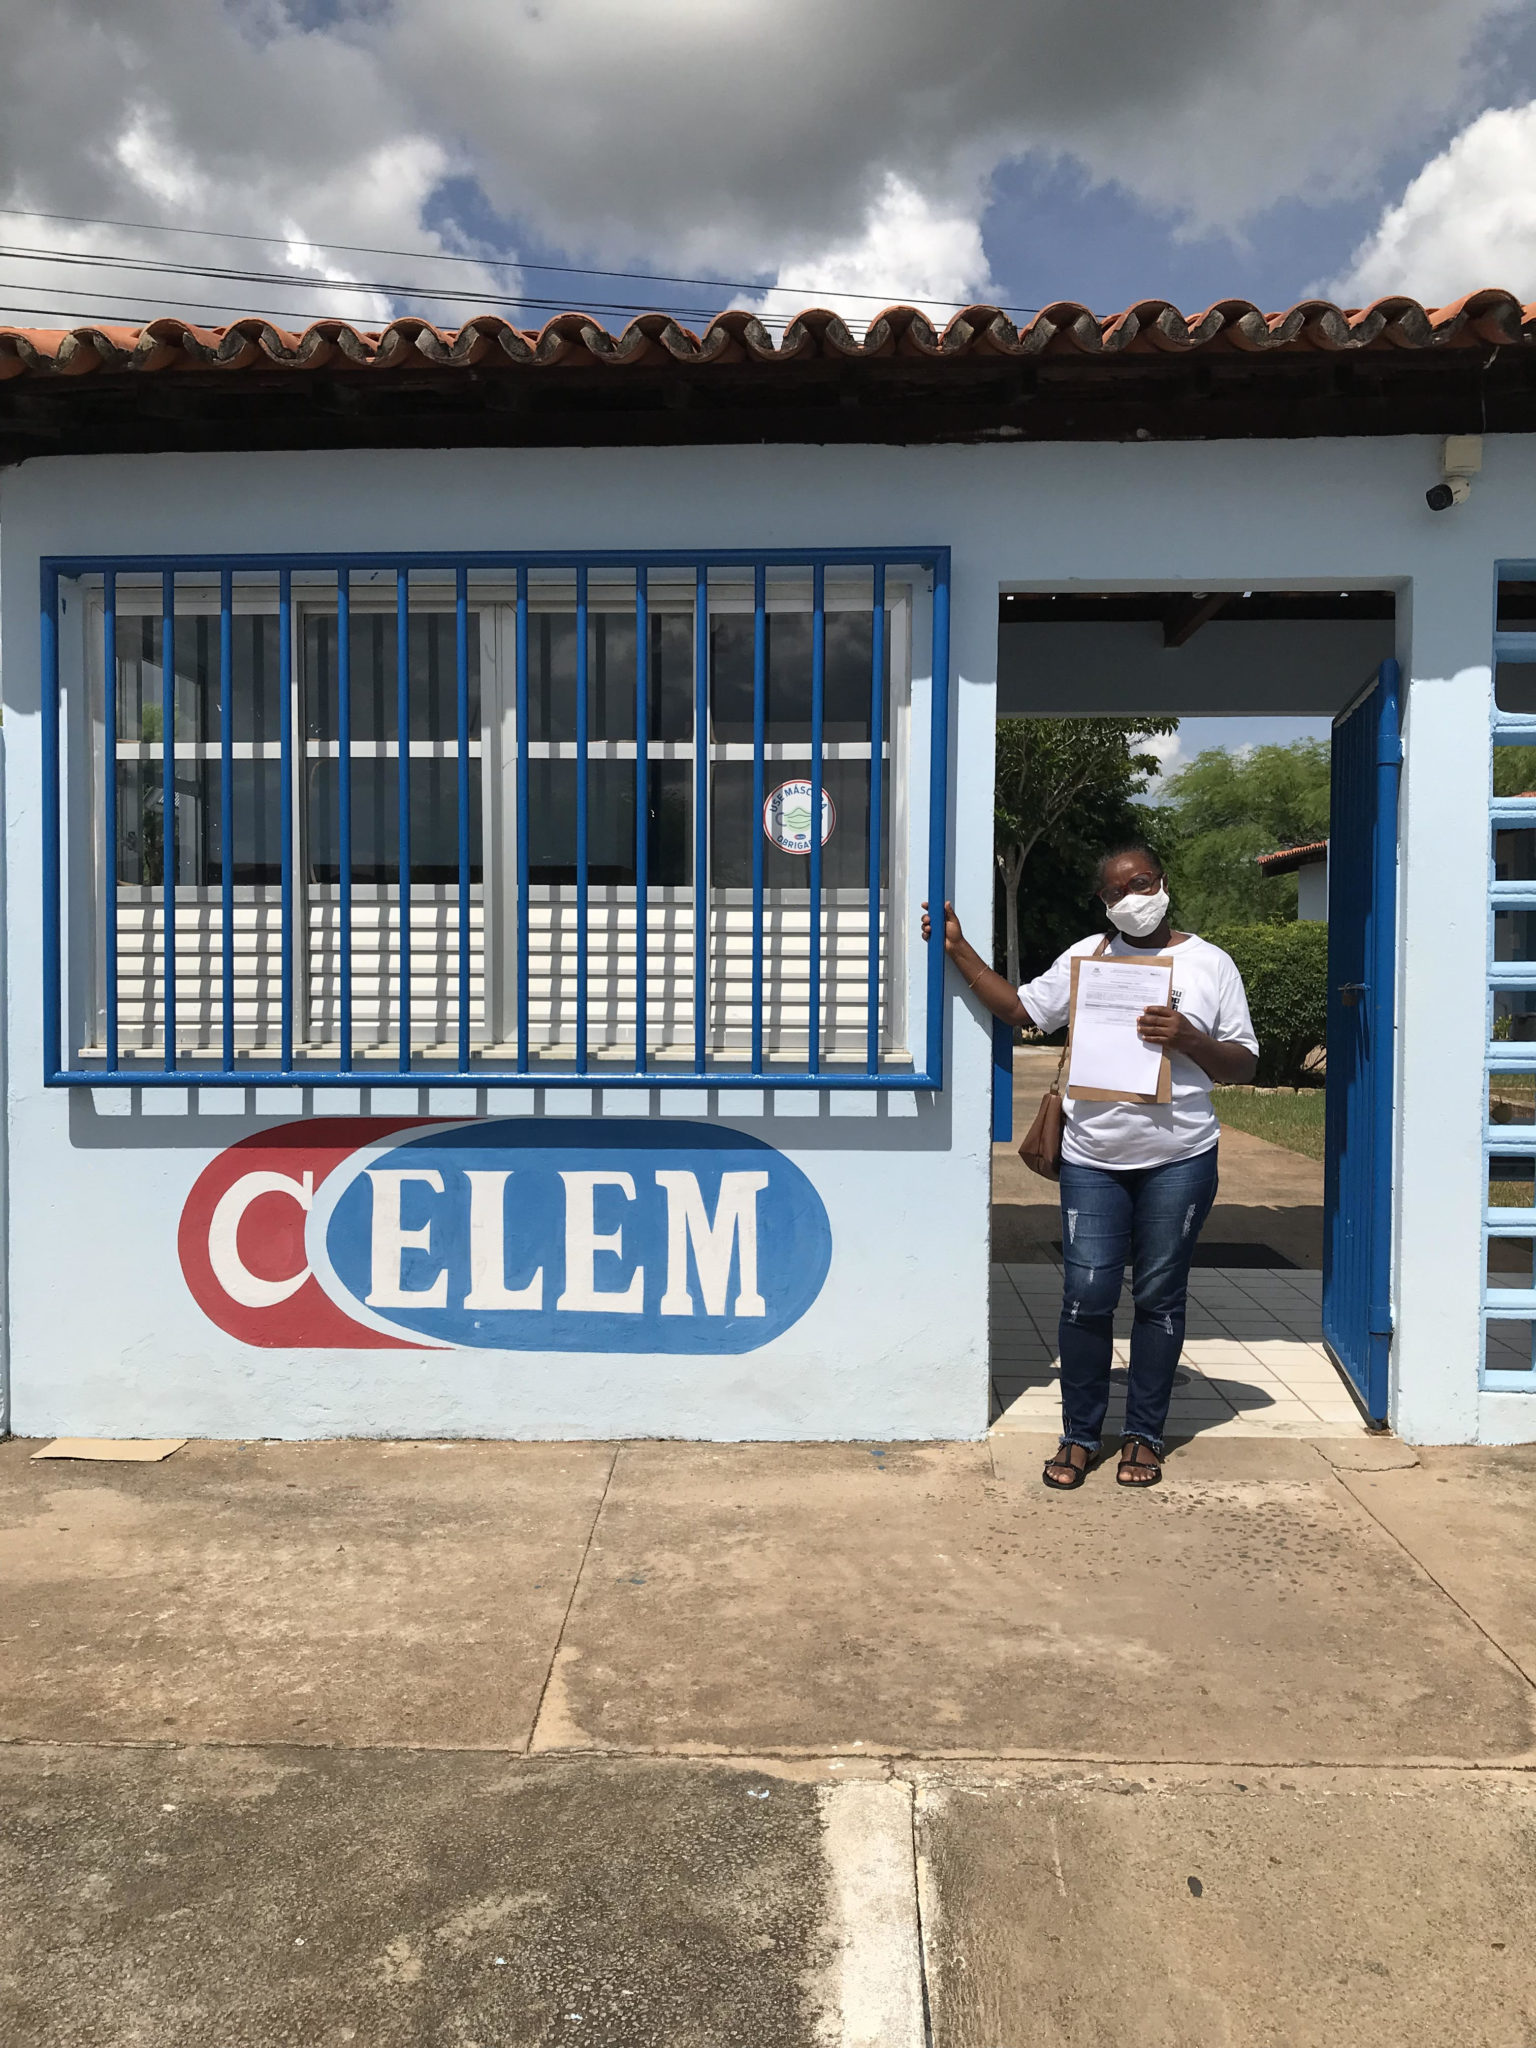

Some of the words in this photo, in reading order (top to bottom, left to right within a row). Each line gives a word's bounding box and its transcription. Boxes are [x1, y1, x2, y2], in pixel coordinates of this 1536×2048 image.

[769, 793, 785, 812] USE
[784, 784, 828, 810] MÁSCA
[208, 1169, 769, 1317] CELEM
